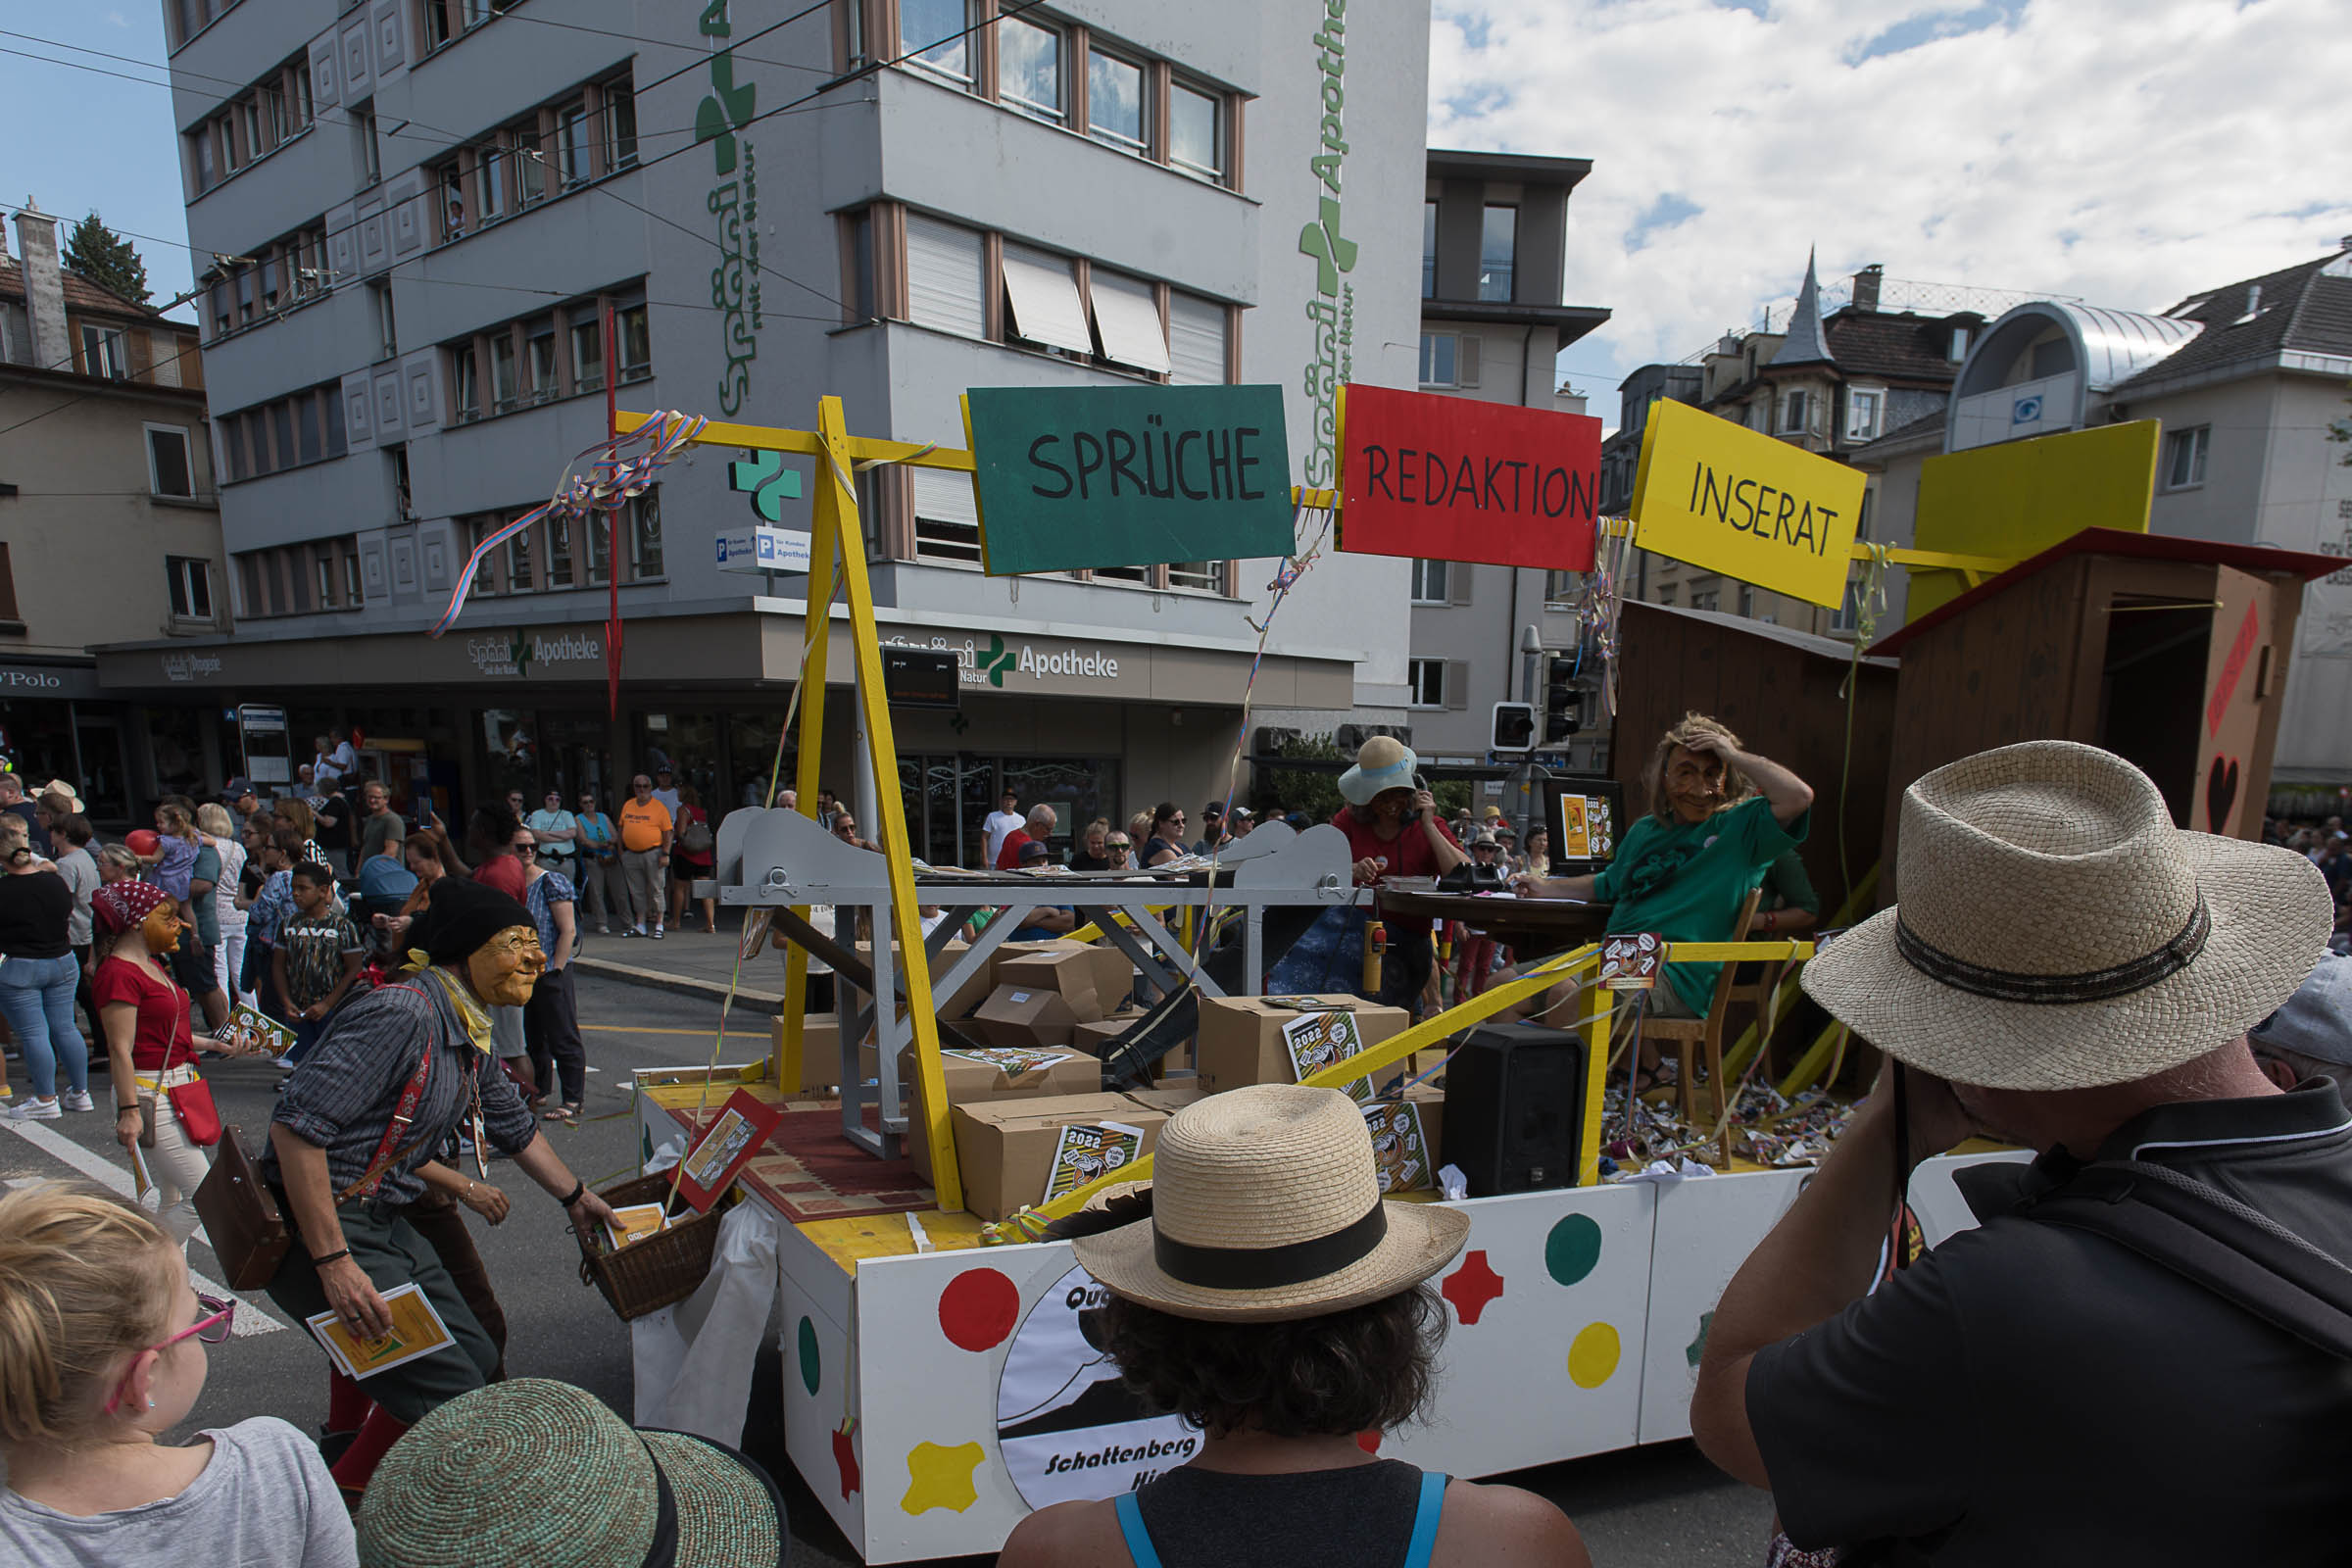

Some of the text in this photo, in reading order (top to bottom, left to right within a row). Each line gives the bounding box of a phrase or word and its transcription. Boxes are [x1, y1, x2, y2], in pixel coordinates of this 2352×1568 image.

[743, 141, 763, 330] mit der Natur
[707, 182, 757, 416] Späni
[1339, 282, 1354, 345] Natur
[1028, 414, 1265, 501] SPRÜCHE
[1362, 445, 1595, 521] REDAKTION
[1690, 462, 1838, 557] INSERAT
[534, 633, 600, 666] Apotheke
[1019, 646, 1118, 679] Apotheke
[959, 670, 988, 683] Natur
[1294, 1027, 1323, 1049] 2022
[1067, 1131, 1102, 1150] 2022
[1045, 1437, 1196, 1475] Schattenberg
